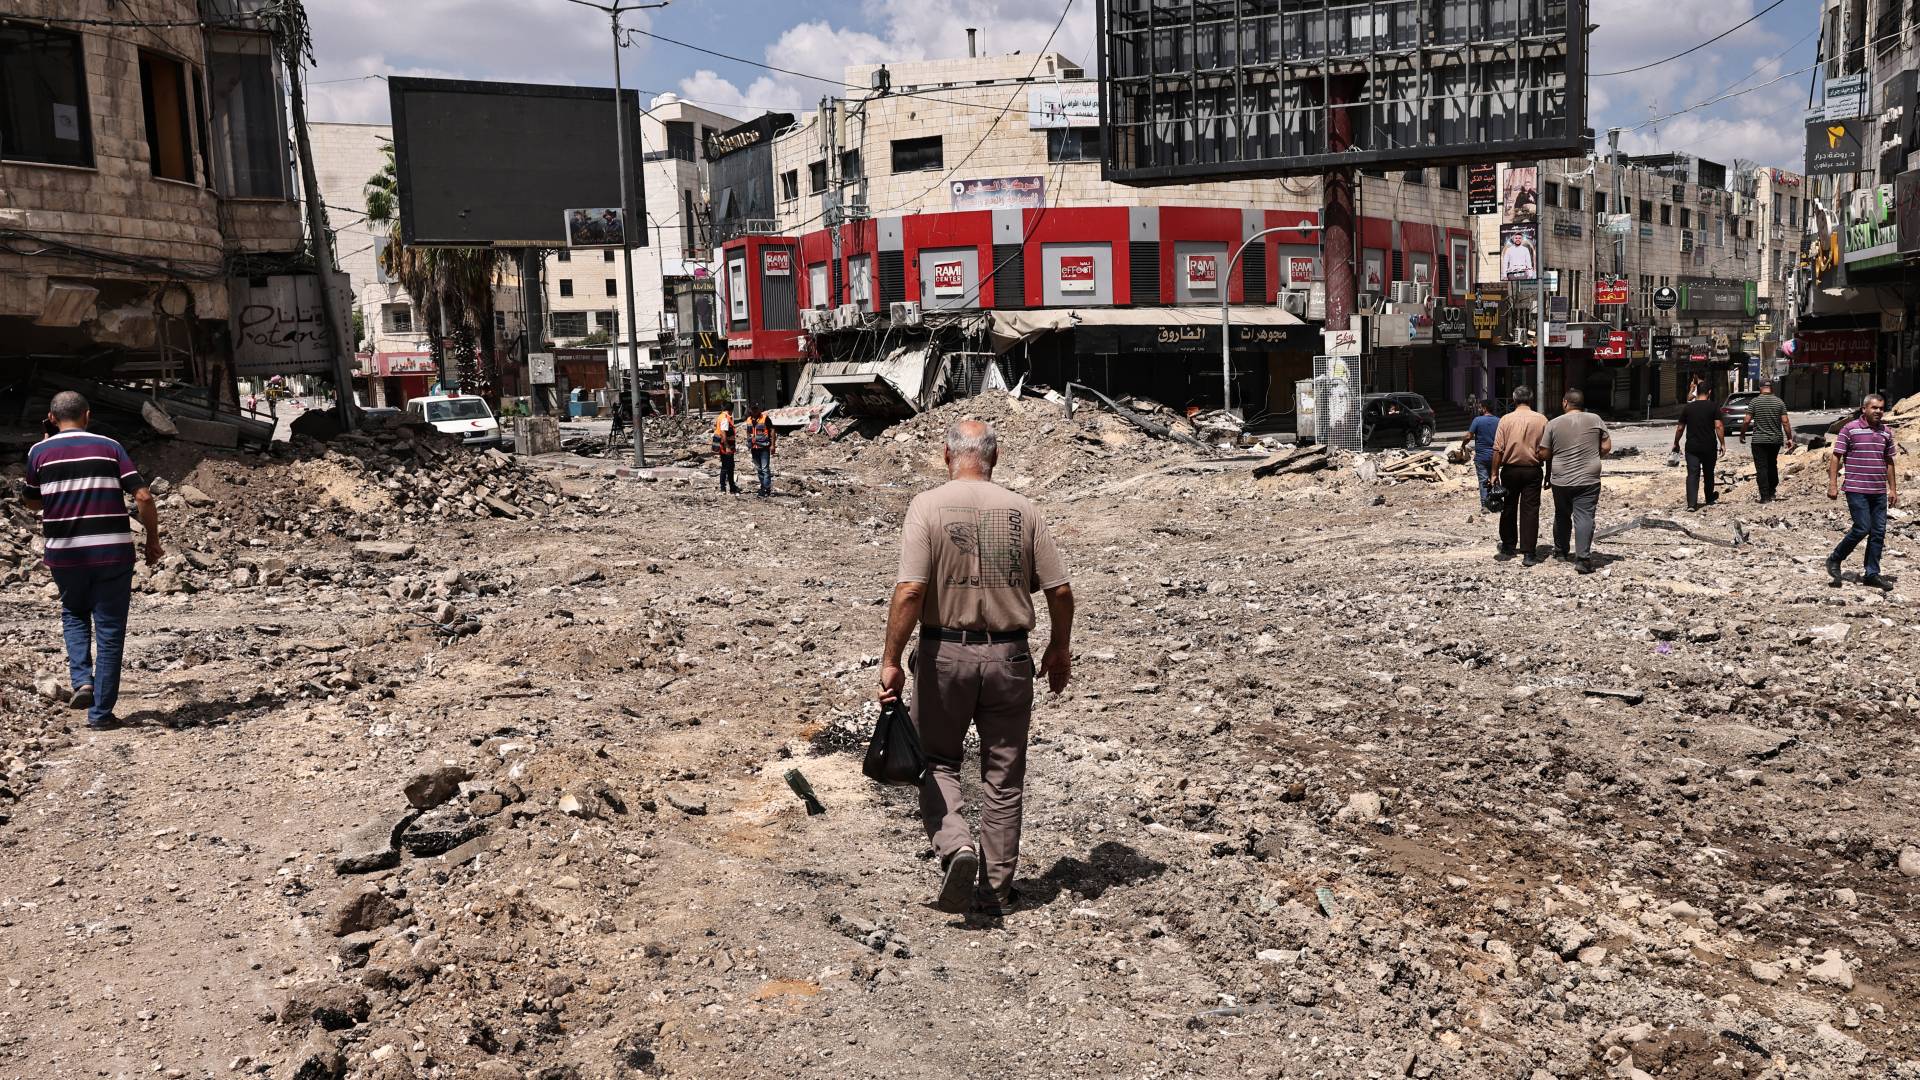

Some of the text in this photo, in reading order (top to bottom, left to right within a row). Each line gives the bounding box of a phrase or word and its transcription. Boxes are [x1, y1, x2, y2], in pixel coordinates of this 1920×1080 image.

[767, 254, 788, 262] RAMI
[1190, 260, 1215, 270] RAMI
[1291, 262, 1312, 271] RAMI
[935, 266, 962, 277] RAMI
[935, 275, 962, 283] CENTER
[1158, 326, 1287, 343] مجوهرات الفاروق
[1335, 332, 1357, 350] Sky
[1008, 508, 1022, 548] NORTH
